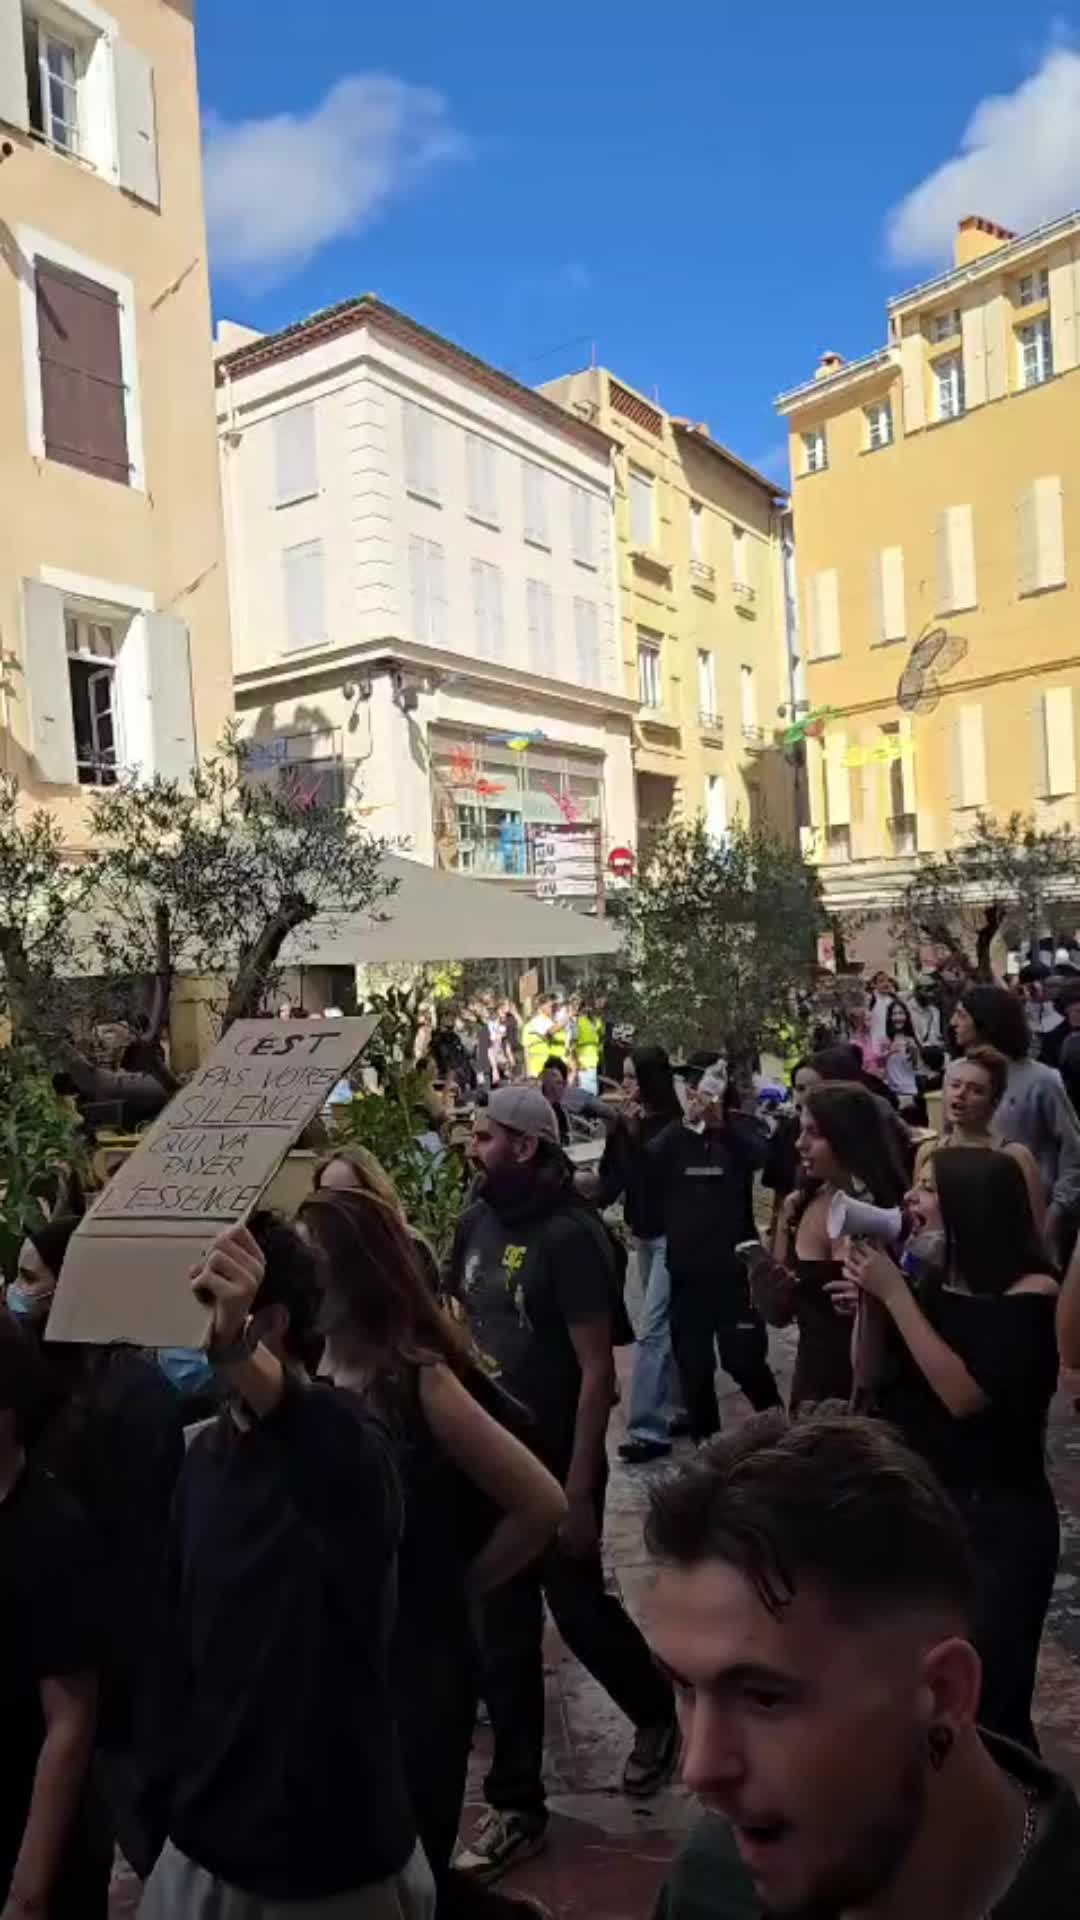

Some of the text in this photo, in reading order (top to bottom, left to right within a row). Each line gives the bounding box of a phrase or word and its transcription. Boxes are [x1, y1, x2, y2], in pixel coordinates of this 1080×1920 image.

[198, 1065, 251, 1087] PAS
[166, 1093, 320, 1127] SILENCE
[149, 1132, 249, 1152] QUI VA
[162, 1154, 244, 1177] PAYER
